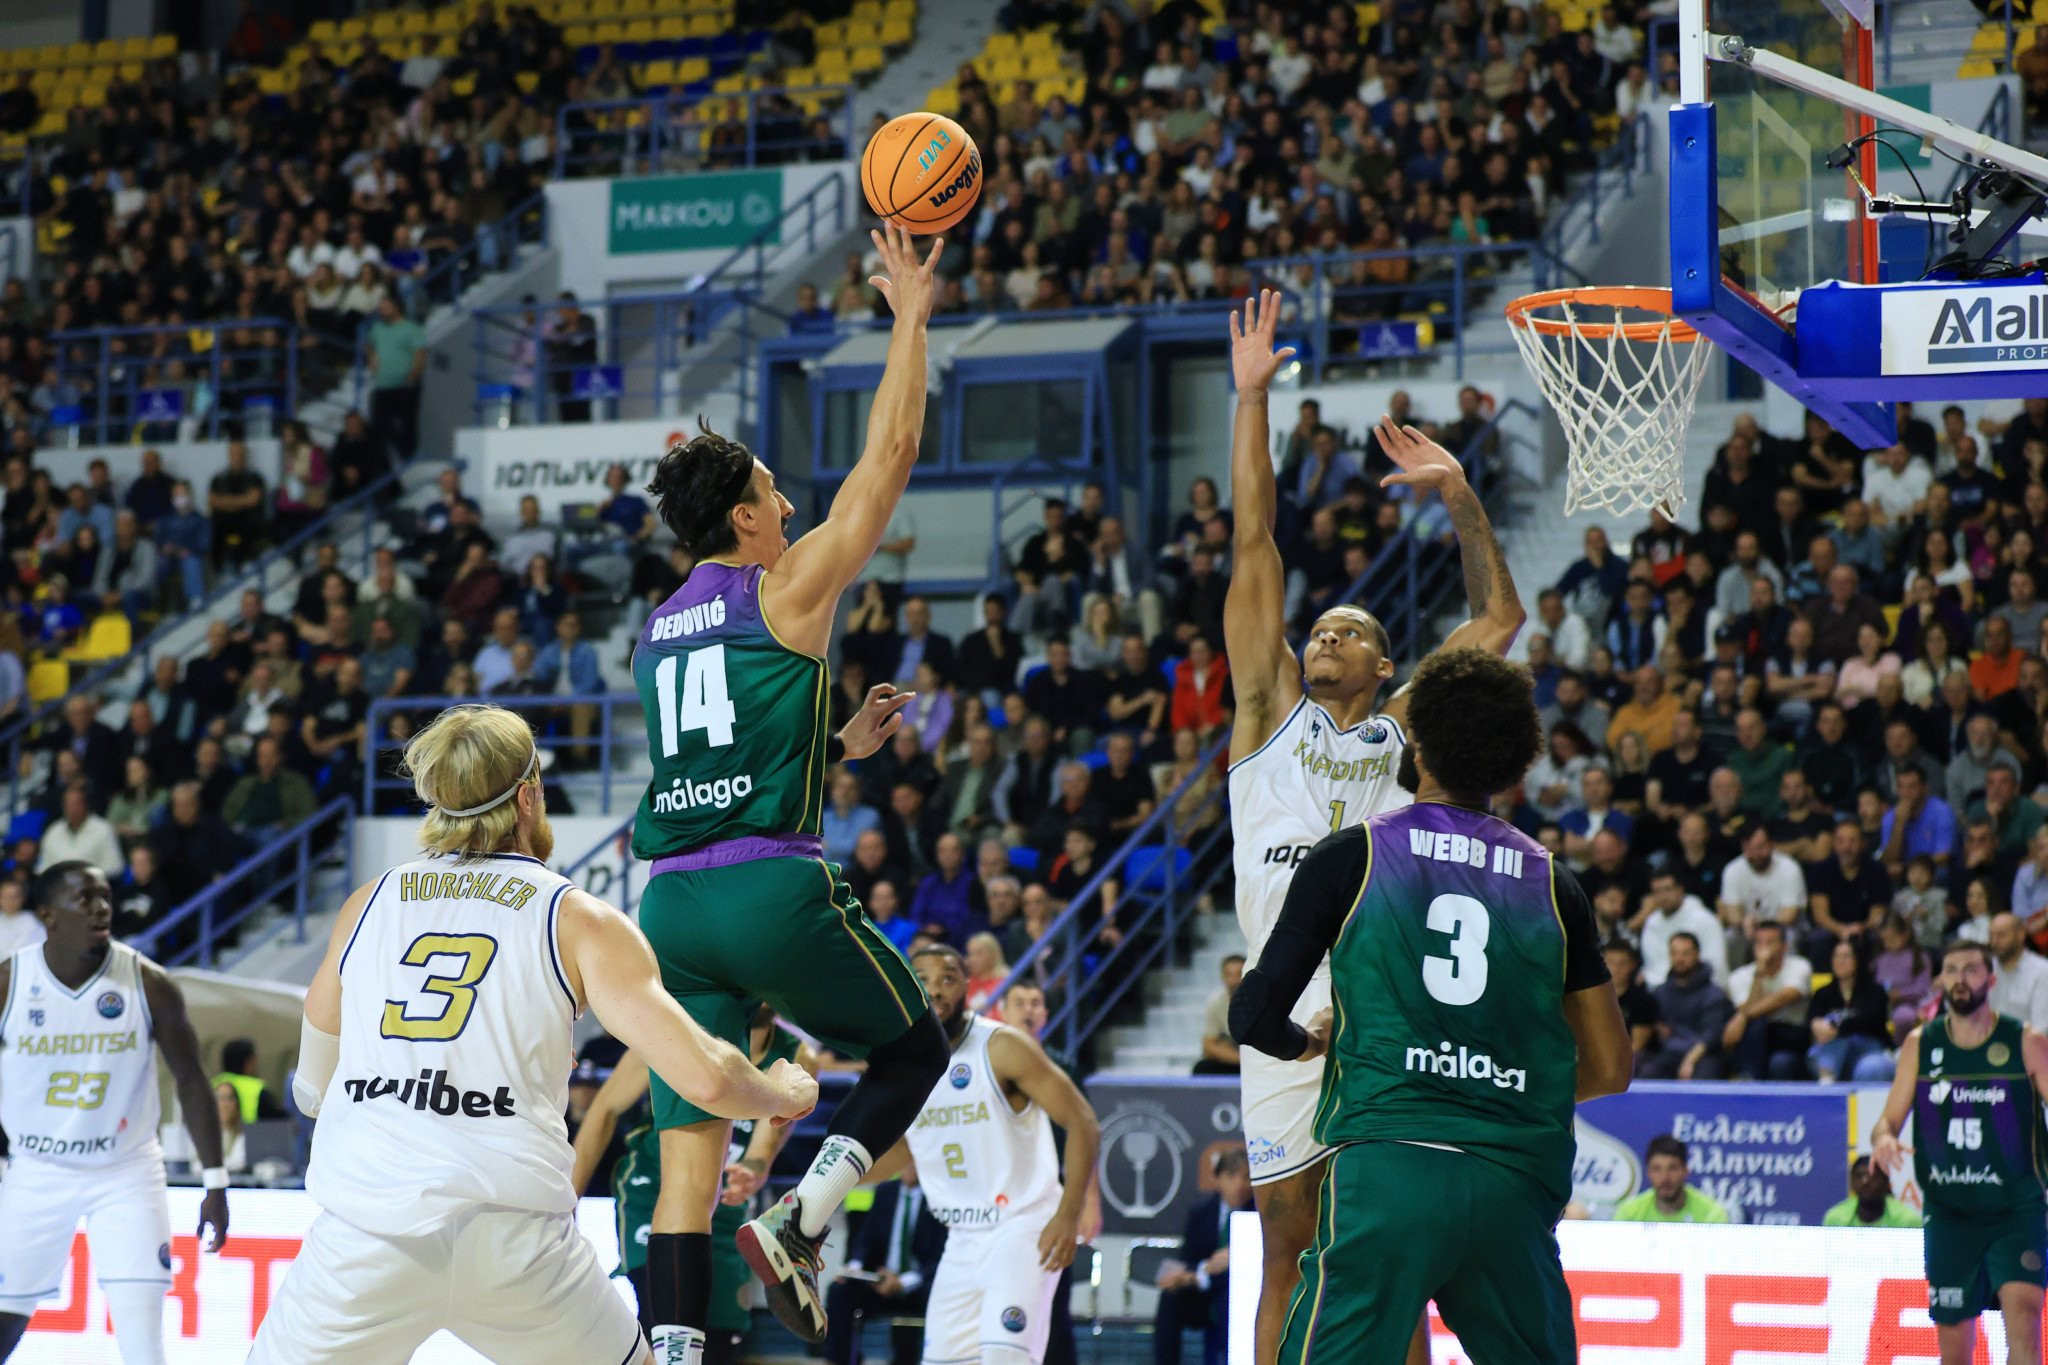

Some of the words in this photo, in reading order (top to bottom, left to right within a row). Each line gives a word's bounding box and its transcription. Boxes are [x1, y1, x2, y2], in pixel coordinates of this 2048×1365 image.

[655, 643, 737, 759] 14
[652, 774, 753, 814] málaga
[1328, 799, 1347, 833] 1
[1409, 827, 1488, 870] WEBB
[1492, 845, 1524, 880] III
[400, 870, 538, 911] HORCHLER
[1422, 893, 1491, 1006] 3
[379, 932, 499, 1043] 3
[17, 1029, 138, 1056] KARDITSA
[45, 1071, 111, 1111] 23
[1952, 1085, 2006, 1106] Unicaja
[915, 1101, 990, 1130] ARDITSA
[1671, 1112, 1806, 1145] Εκλεκτό
[1947, 1117, 1982, 1150] 45
[942, 1143, 968, 1180] 2
[1687, 1145, 1814, 1176] λληνικό
